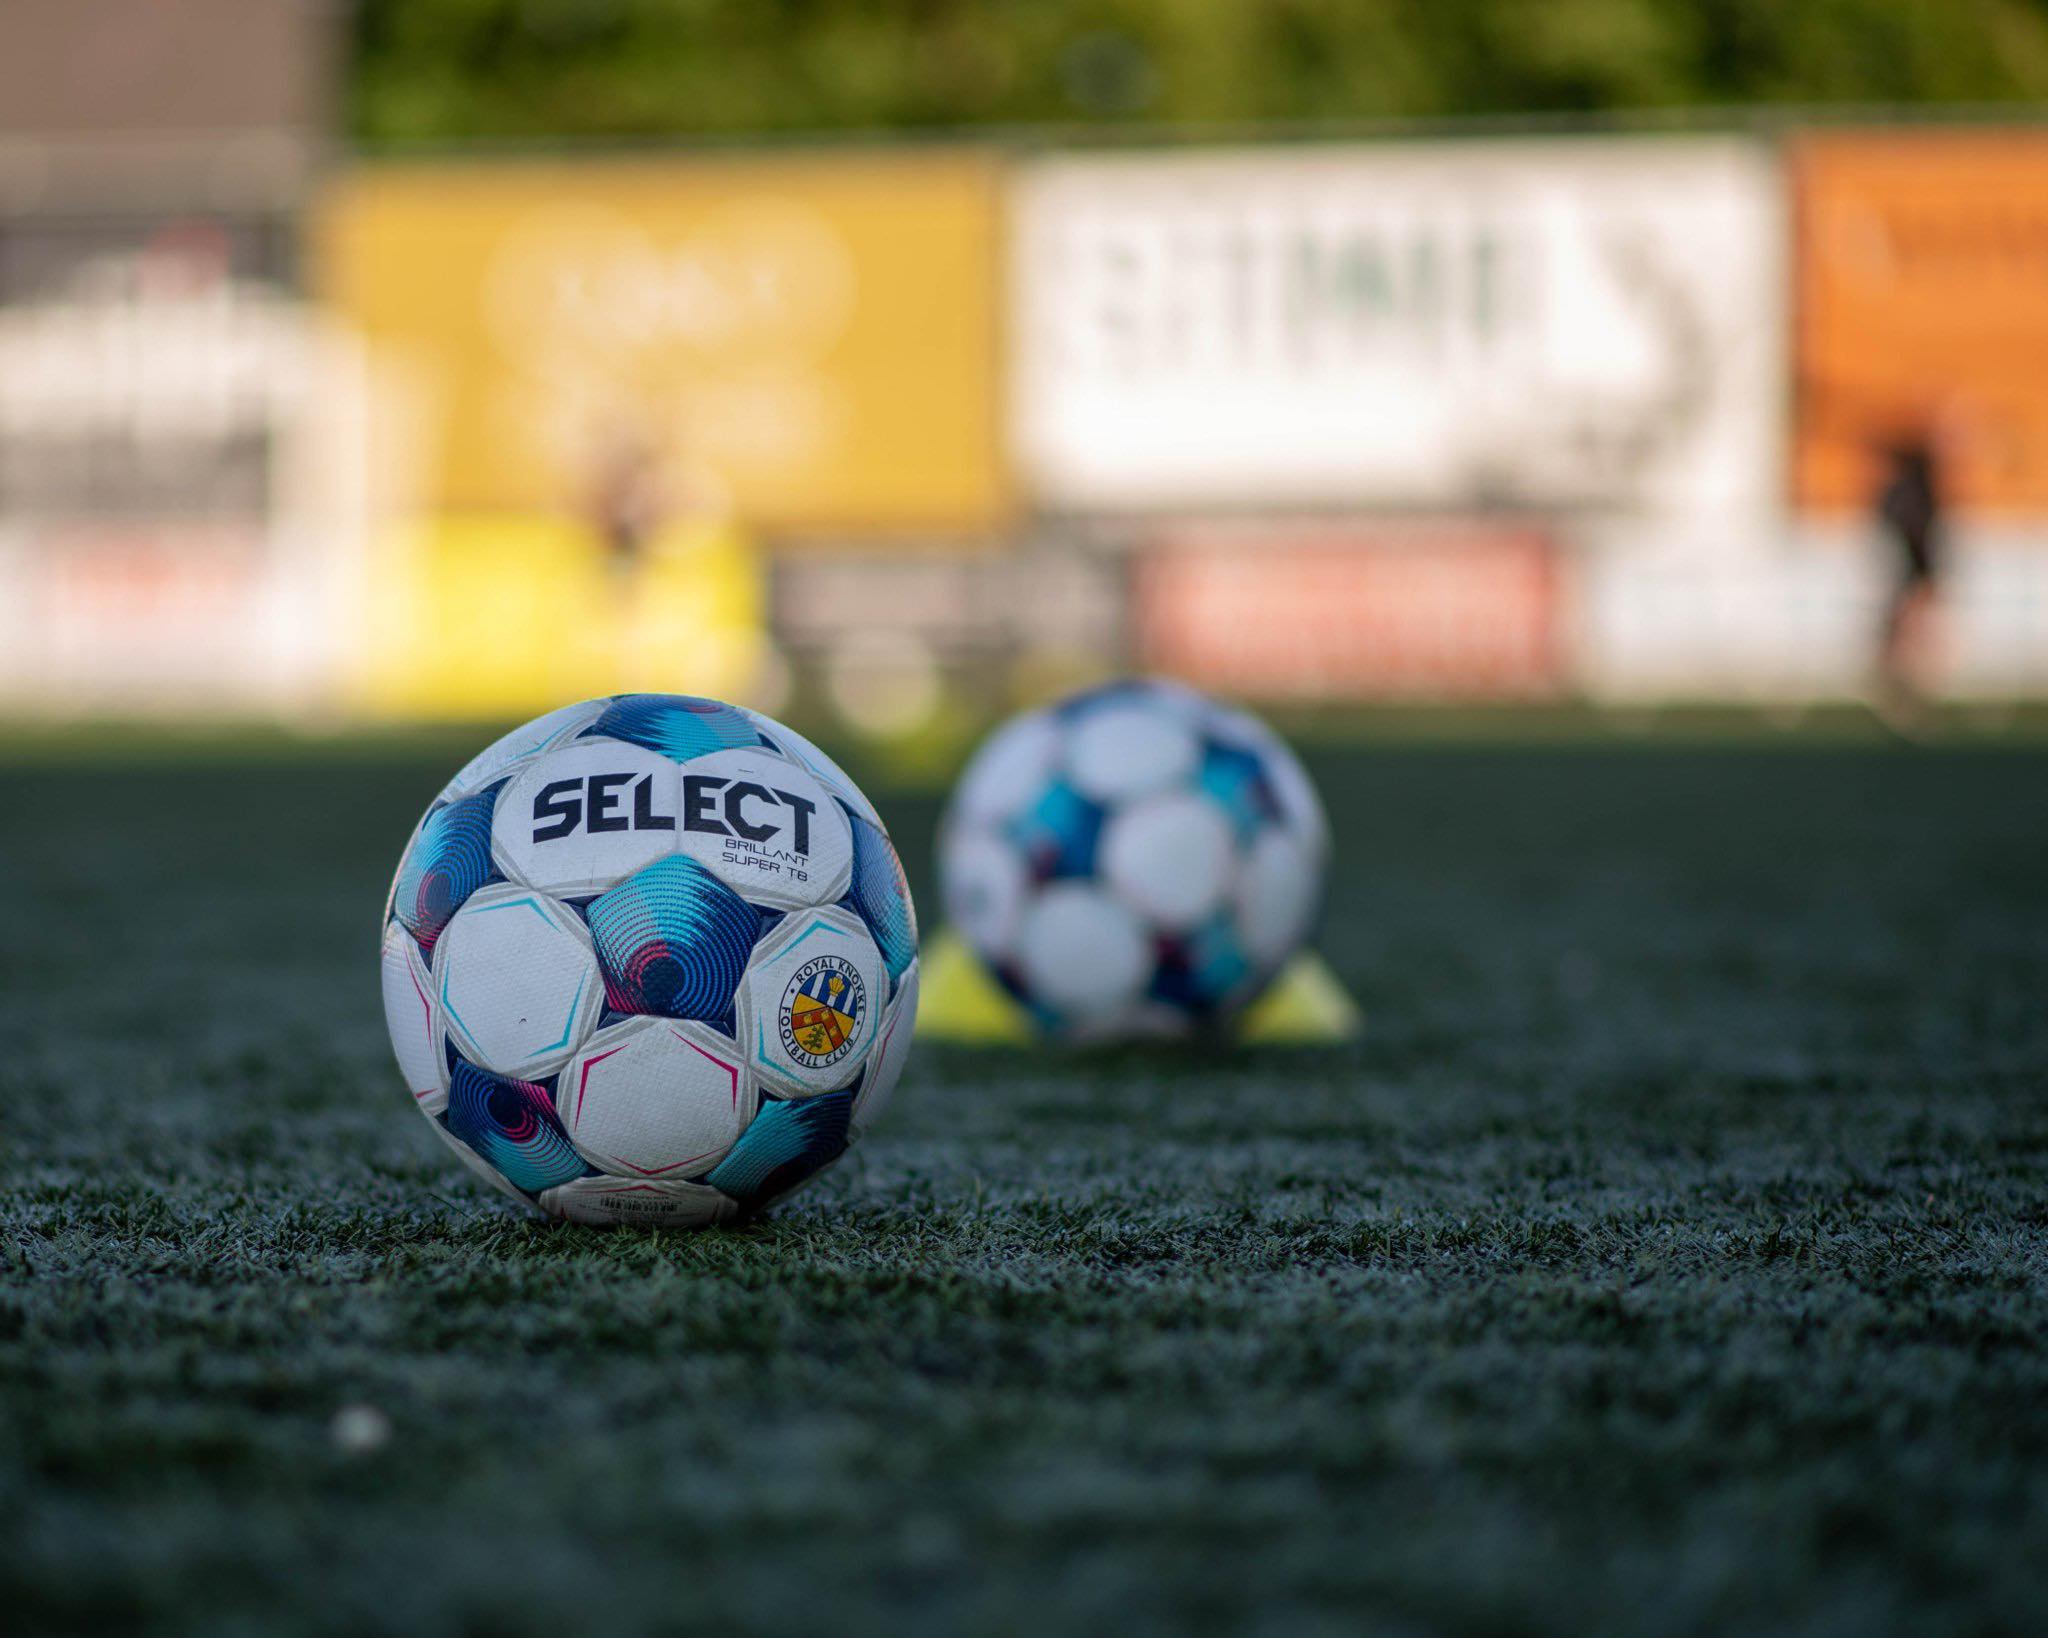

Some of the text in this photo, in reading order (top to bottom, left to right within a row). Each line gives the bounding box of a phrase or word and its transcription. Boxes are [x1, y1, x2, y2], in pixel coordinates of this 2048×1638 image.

[533, 773, 816, 857] SELECT
[722, 852, 808, 882] SUPER TB
[725, 838, 808, 867] BRILLANT
[796, 958, 865, 1012] ROYAL KNOKKE
[781, 1006, 856, 1066] FOOTBALL CLUB
